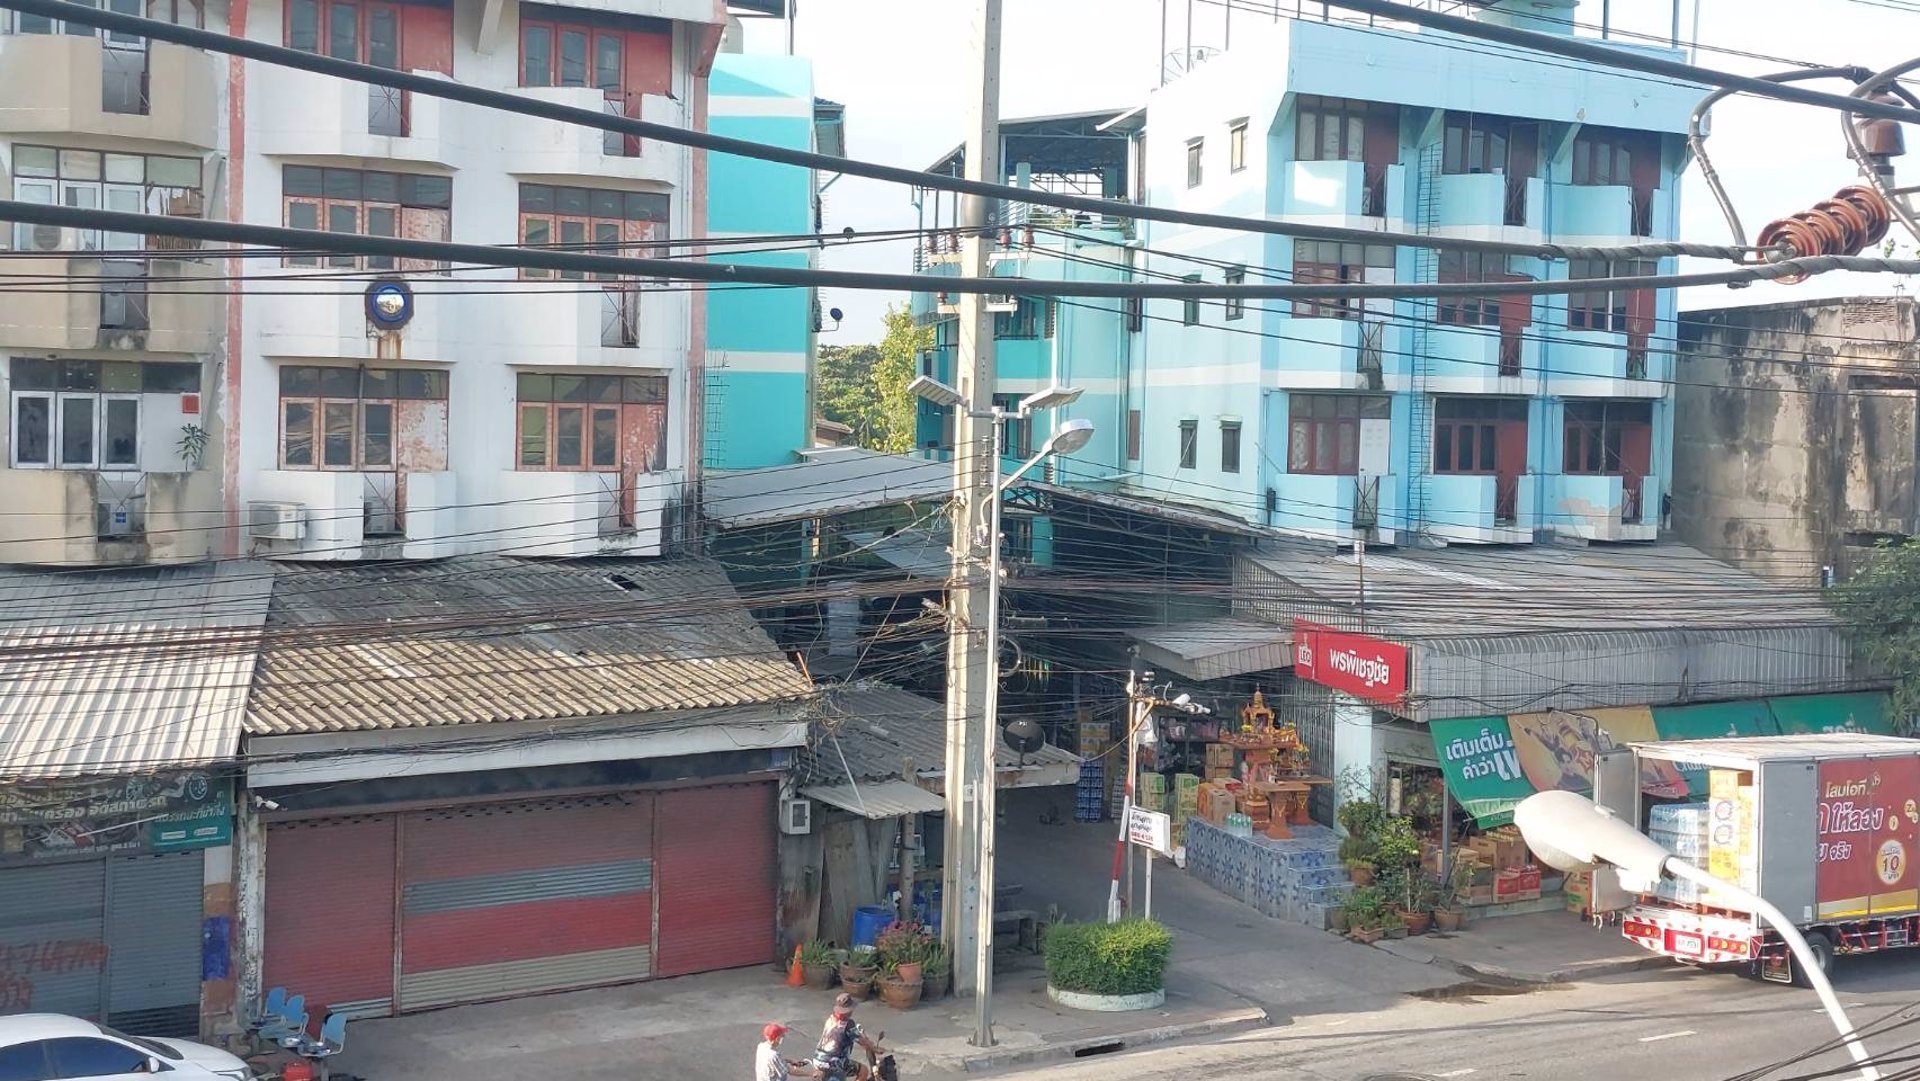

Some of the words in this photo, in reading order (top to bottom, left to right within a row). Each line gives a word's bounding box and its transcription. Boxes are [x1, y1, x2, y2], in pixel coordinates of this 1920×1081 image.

[1329, 648, 1390, 687] พรพิเชฐชัย
[1446, 728, 1504, 761] เติมเต็ม
[1830, 841, 1852, 860] จริง
[1883, 855, 1900, 872] 10
